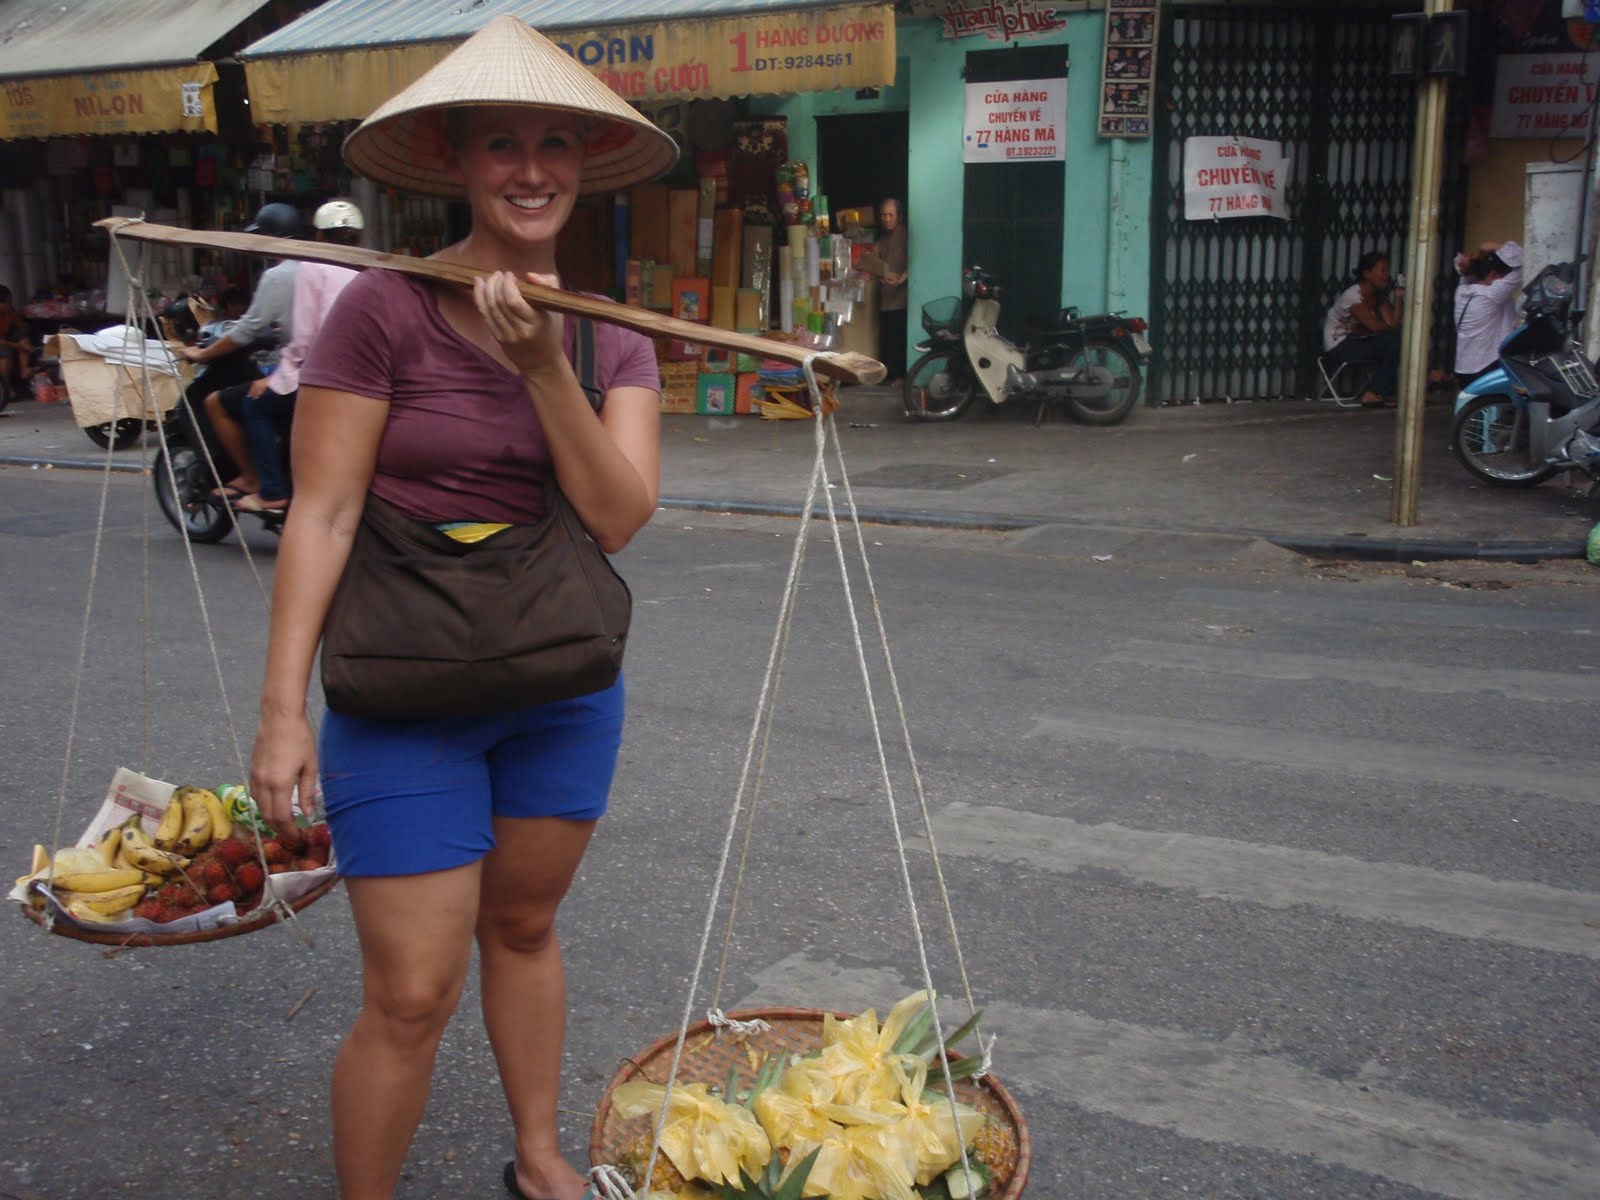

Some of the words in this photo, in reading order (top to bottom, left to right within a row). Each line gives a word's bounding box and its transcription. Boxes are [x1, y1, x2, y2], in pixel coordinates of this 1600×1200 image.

[730, 31, 753, 73] 1
[73, 93, 145, 118] NILON
[1013, 88, 1048, 103] HÀNG
[976, 130, 992, 144] 77
[995, 126, 1030, 143] HÀNG
[1034, 124, 1056, 142] MÃ
[1209, 197, 1223, 212] 77
